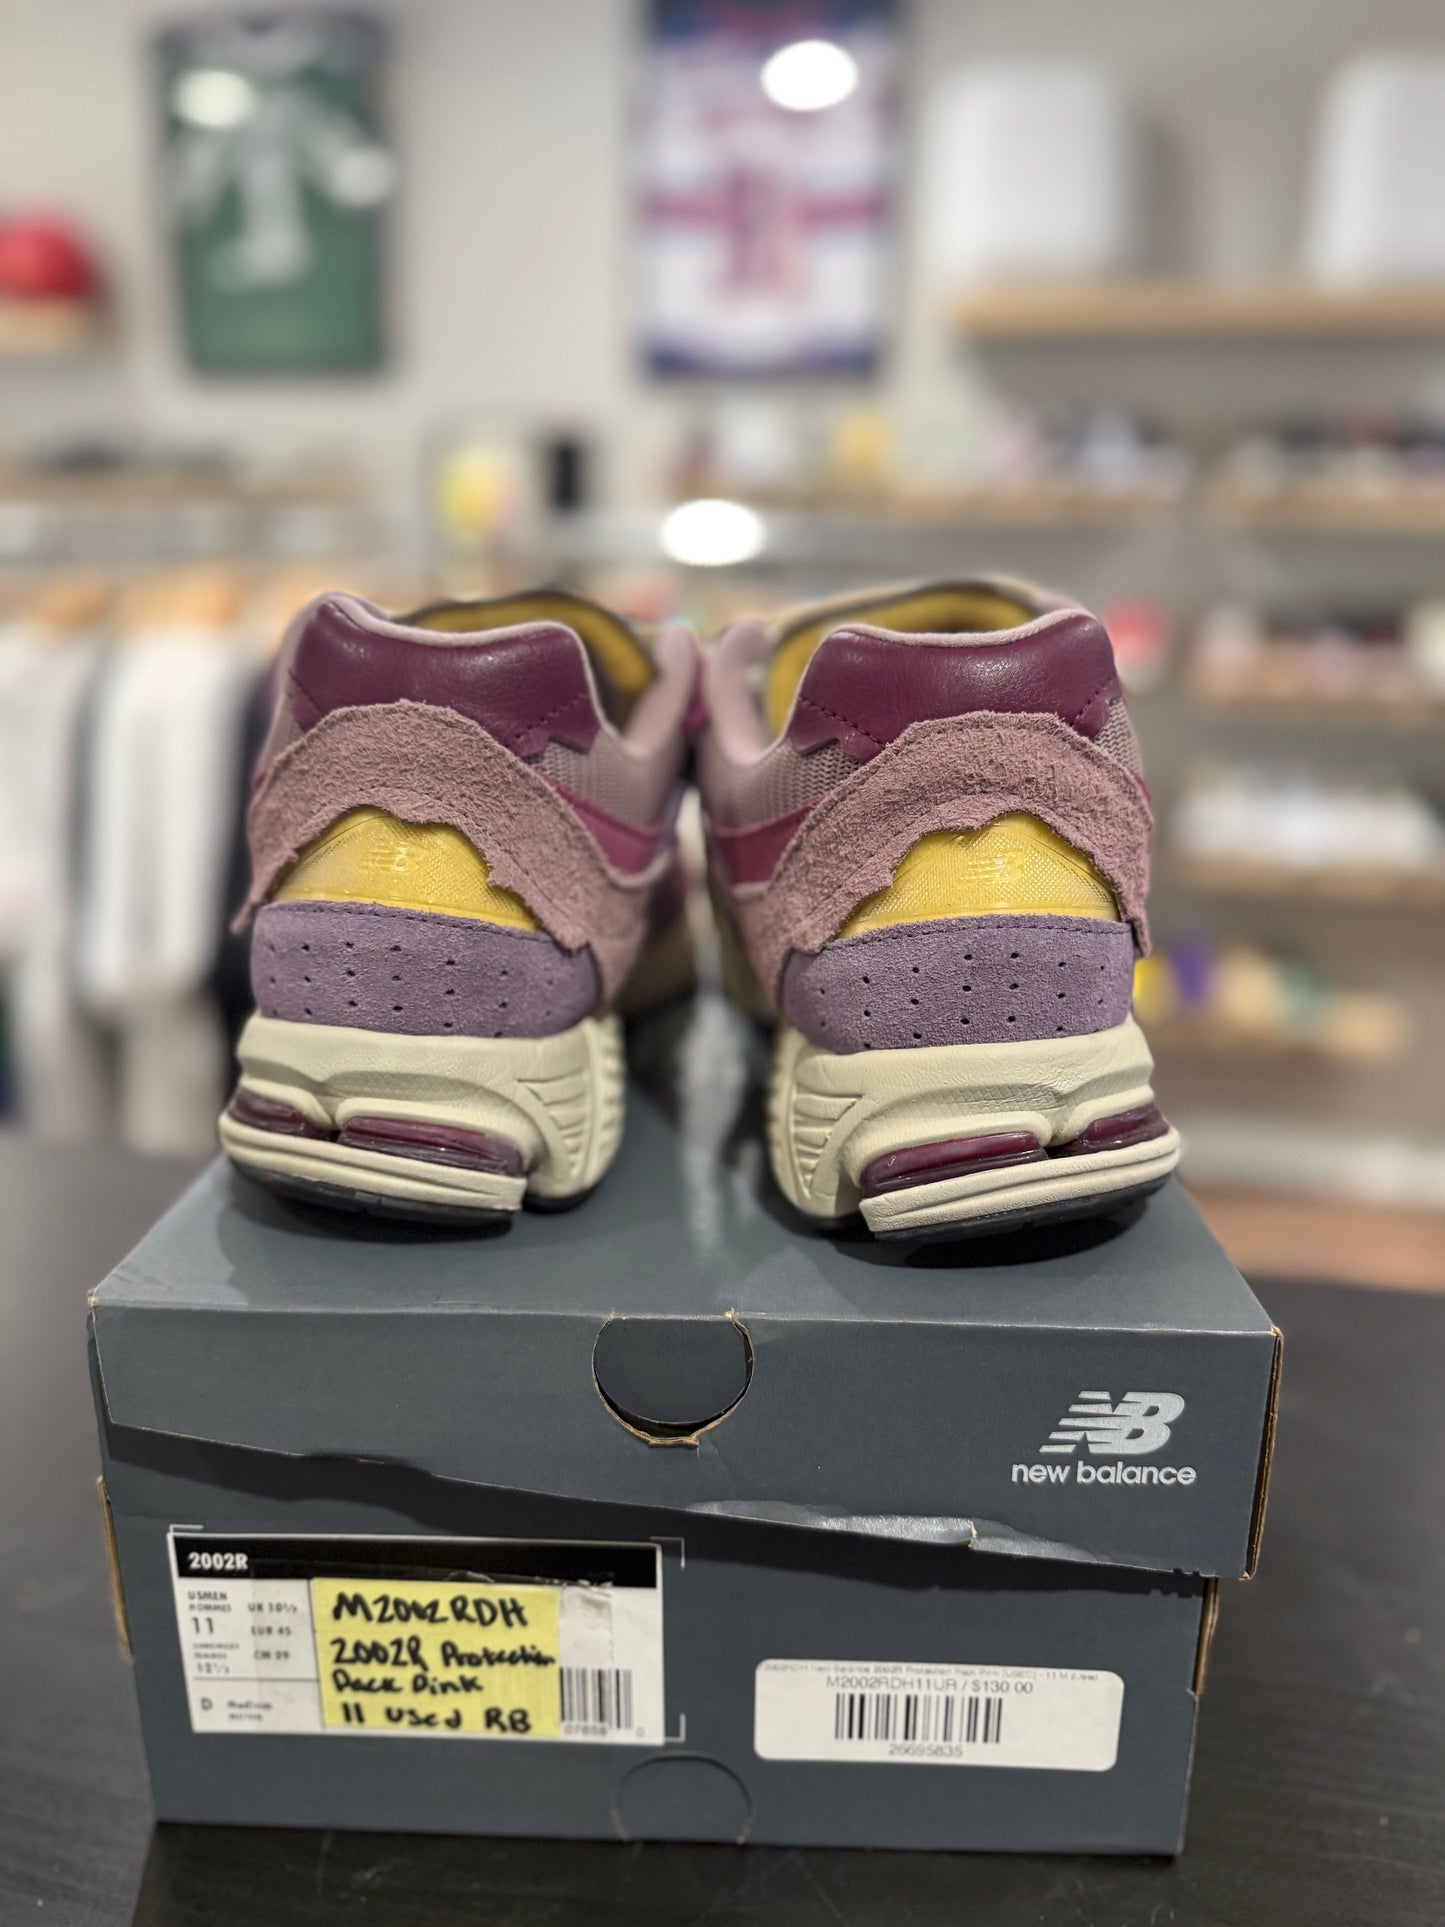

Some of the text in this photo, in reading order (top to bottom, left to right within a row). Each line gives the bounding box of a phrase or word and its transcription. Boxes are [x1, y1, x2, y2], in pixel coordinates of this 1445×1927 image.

[1039, 1390, 1185, 1455] NB
[1011, 1460, 1197, 1485] new balance
[188, 1551, 249, 1570] 2002R
[248, 1602, 264, 1612] UK
[192, 1616, 214, 1635] 11
[251, 1625, 292, 1636] EUR 45
[971, 1680, 1034, 1693] $130.00
[342, 1702, 365, 1724] 11
[484, 1707, 531, 1733] RB
